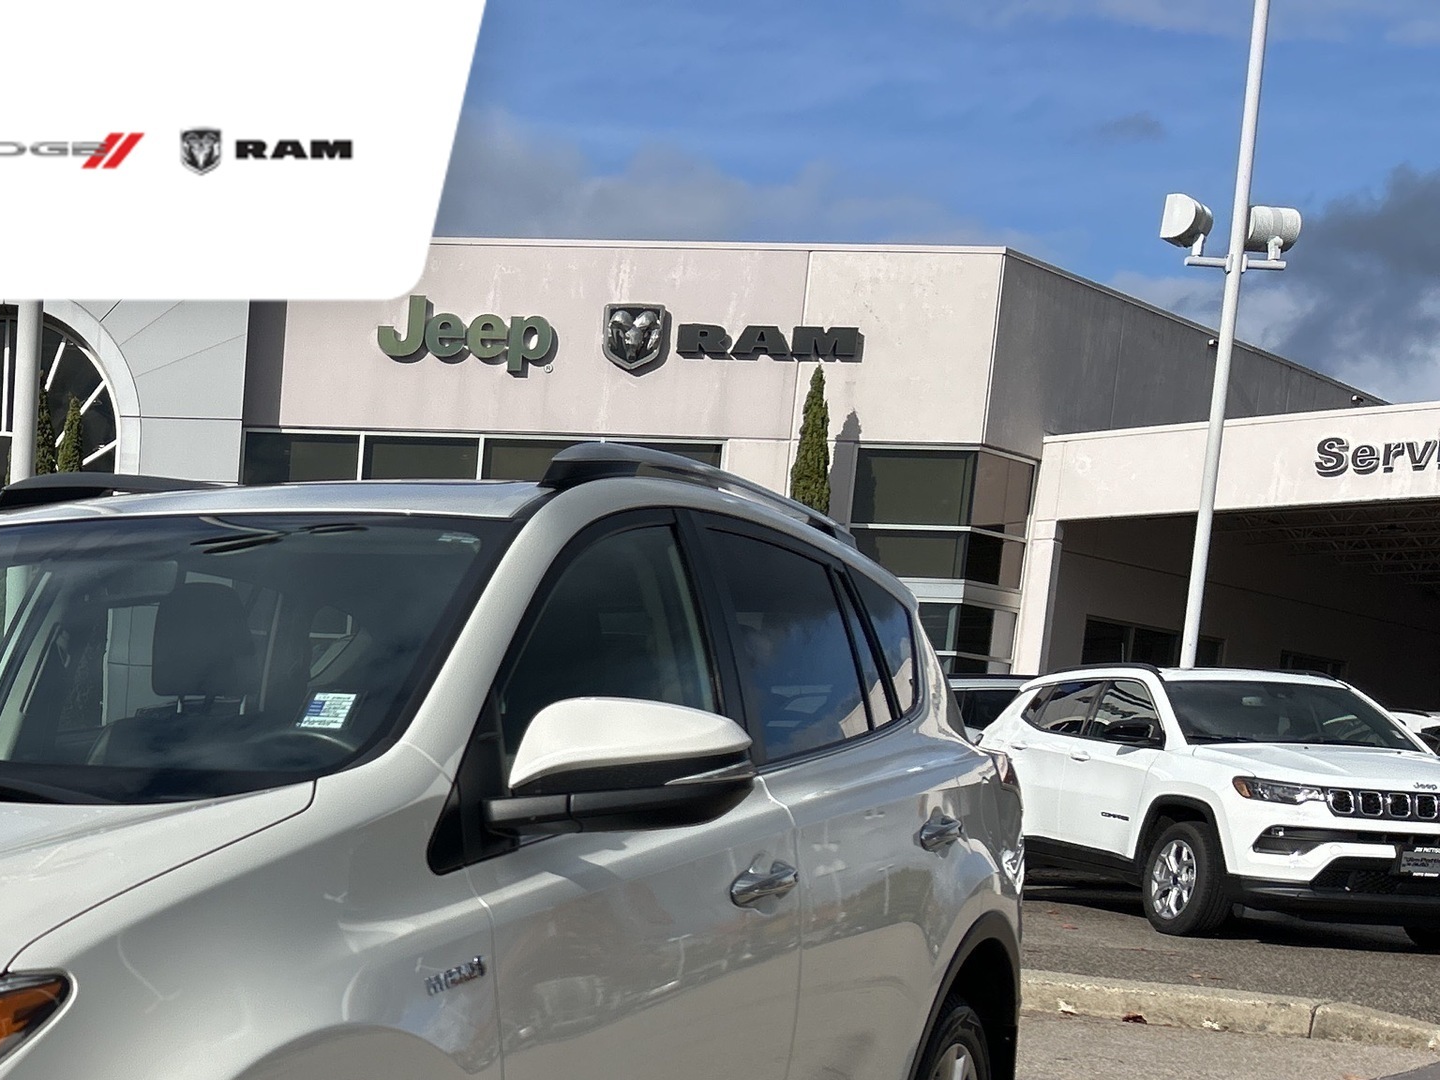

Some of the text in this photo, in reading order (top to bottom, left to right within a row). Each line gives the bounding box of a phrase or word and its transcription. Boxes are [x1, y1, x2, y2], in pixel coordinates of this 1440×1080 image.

[377, 295, 556, 377] Jeep
[677, 323, 863, 362] RAM
[1314, 437, 1440, 477] Serv
